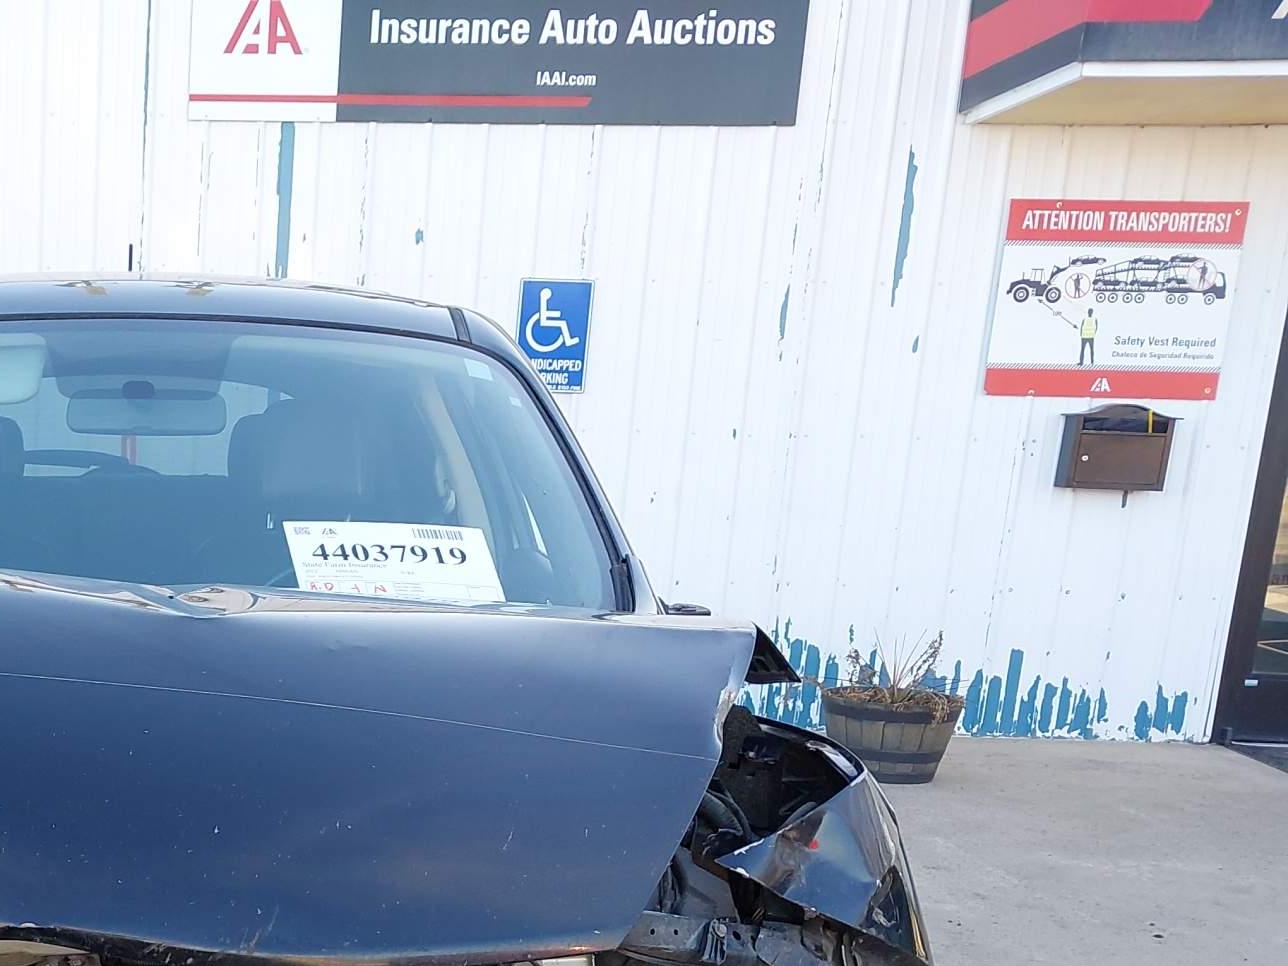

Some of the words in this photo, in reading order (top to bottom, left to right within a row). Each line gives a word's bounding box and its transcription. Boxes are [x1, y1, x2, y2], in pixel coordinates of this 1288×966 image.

[370, 9, 531, 45] Insurance
[538, 9, 618, 45] Auto
[625, 10, 776, 46] Auctions
[536, 71, 597, 86] IAAI.com
[1022, 209, 1104, 231] ATTENTION
[1108, 211, 1231, 233] TRANSPORTERS!
[1114, 335, 1145, 347] Safety
[1148, 336, 1169, 346] Vest
[1171, 337, 1216, 349] Required
[531, 358, 582, 372] NDICAPPED
[540, 372, 569, 385] RKING
[312, 543, 467, 566] 44037919
